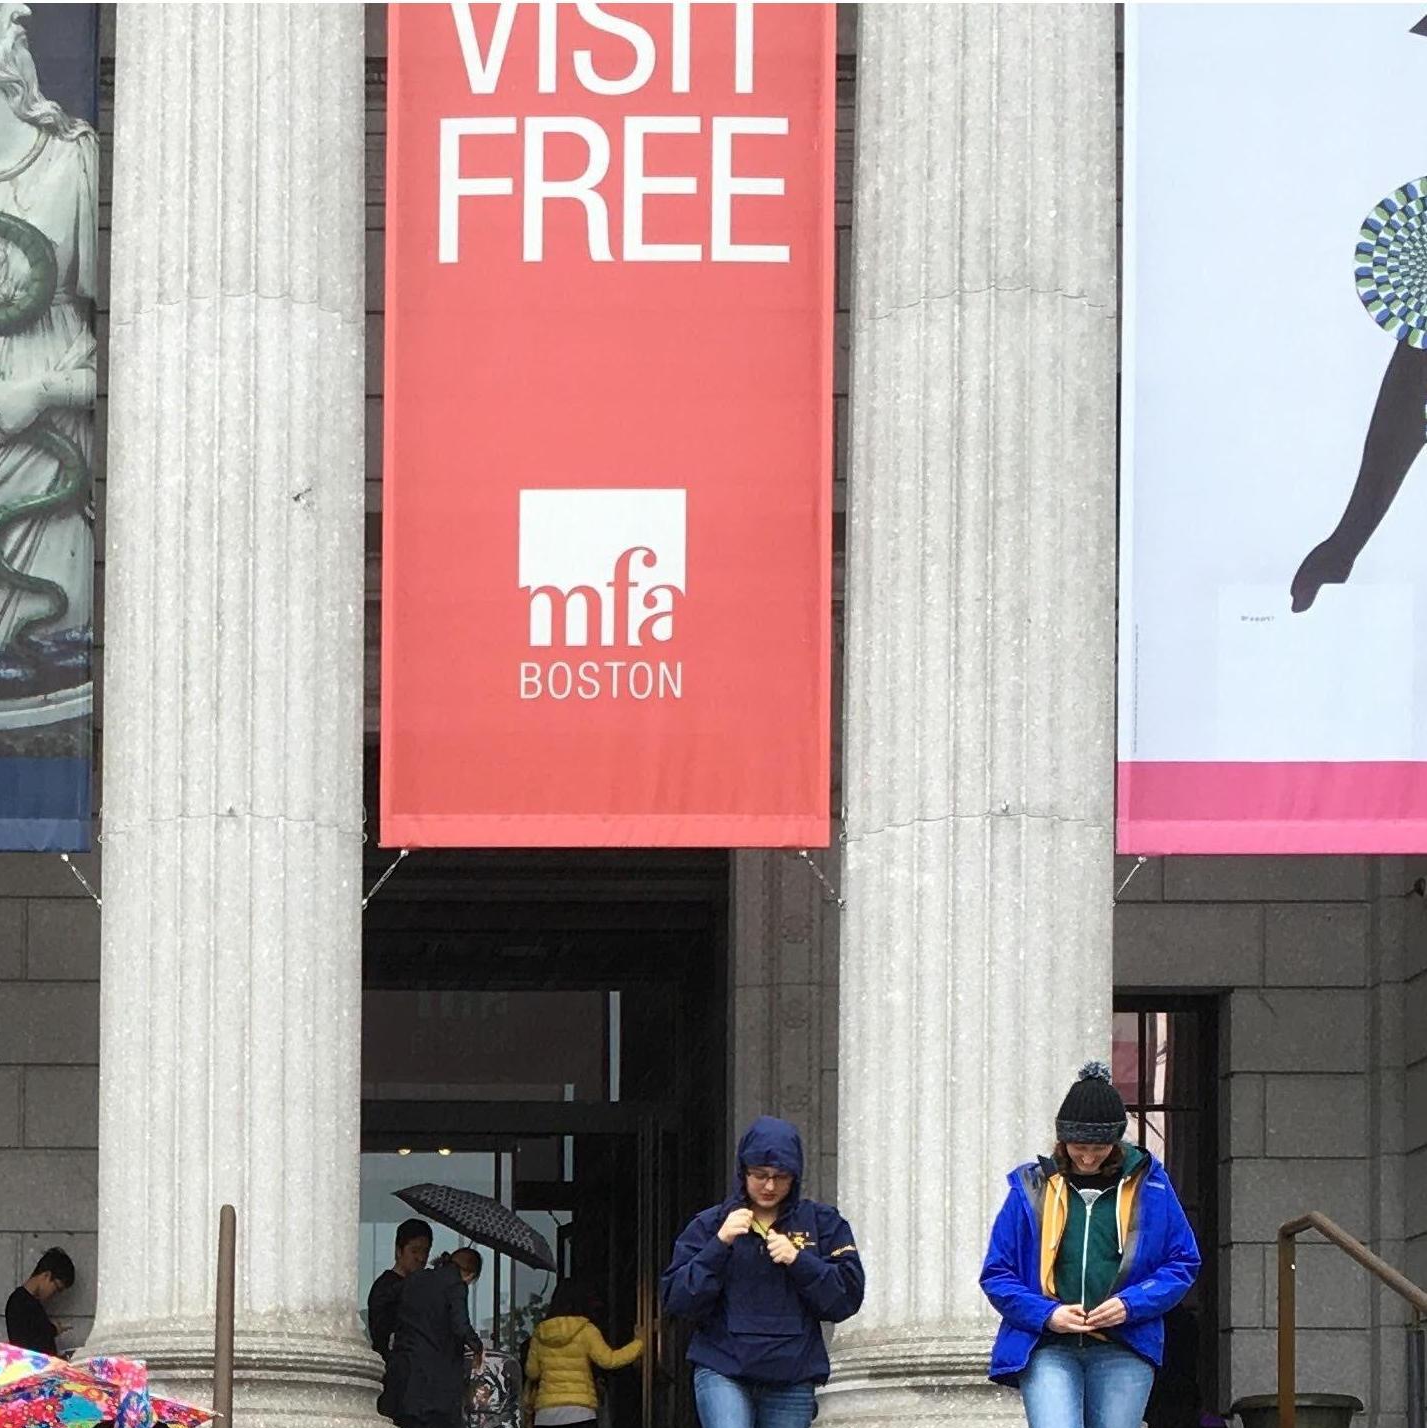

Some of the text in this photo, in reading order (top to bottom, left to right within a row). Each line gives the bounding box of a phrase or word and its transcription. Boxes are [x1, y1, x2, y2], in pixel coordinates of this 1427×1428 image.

[438, 116, 790, 264] FREE
[518, 545, 687, 648] mfa
[519, 661, 683, 700] BOSTON
